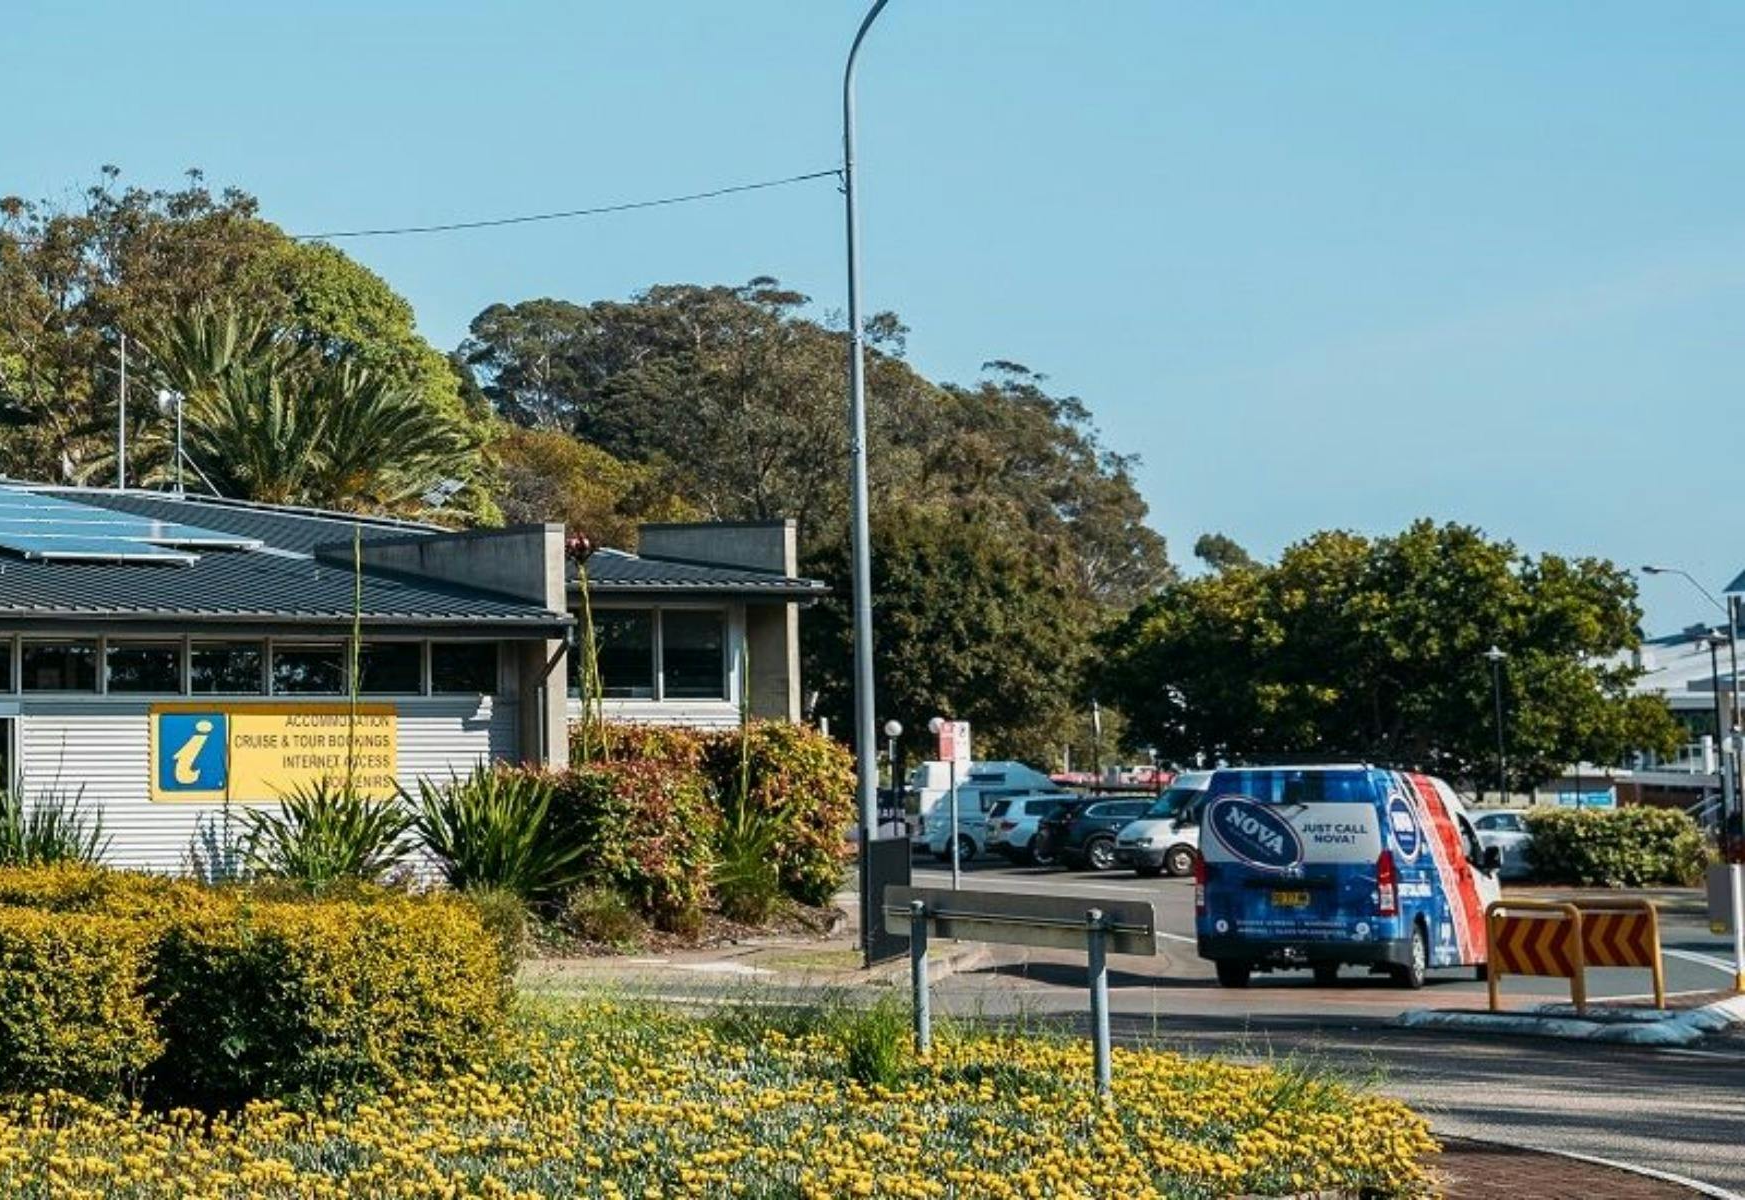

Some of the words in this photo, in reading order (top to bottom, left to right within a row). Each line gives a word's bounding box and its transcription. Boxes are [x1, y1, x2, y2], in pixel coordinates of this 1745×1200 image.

[234, 735, 277, 748] CRUISE
[281, 735, 289, 748] &
[294, 735, 326, 747] TOUR
[283, 754, 340, 768] INTERNET
[1225, 806, 1284, 857] NOVA
[1302, 825, 1331, 834] JUST
[1335, 825, 1367, 834] CALL
